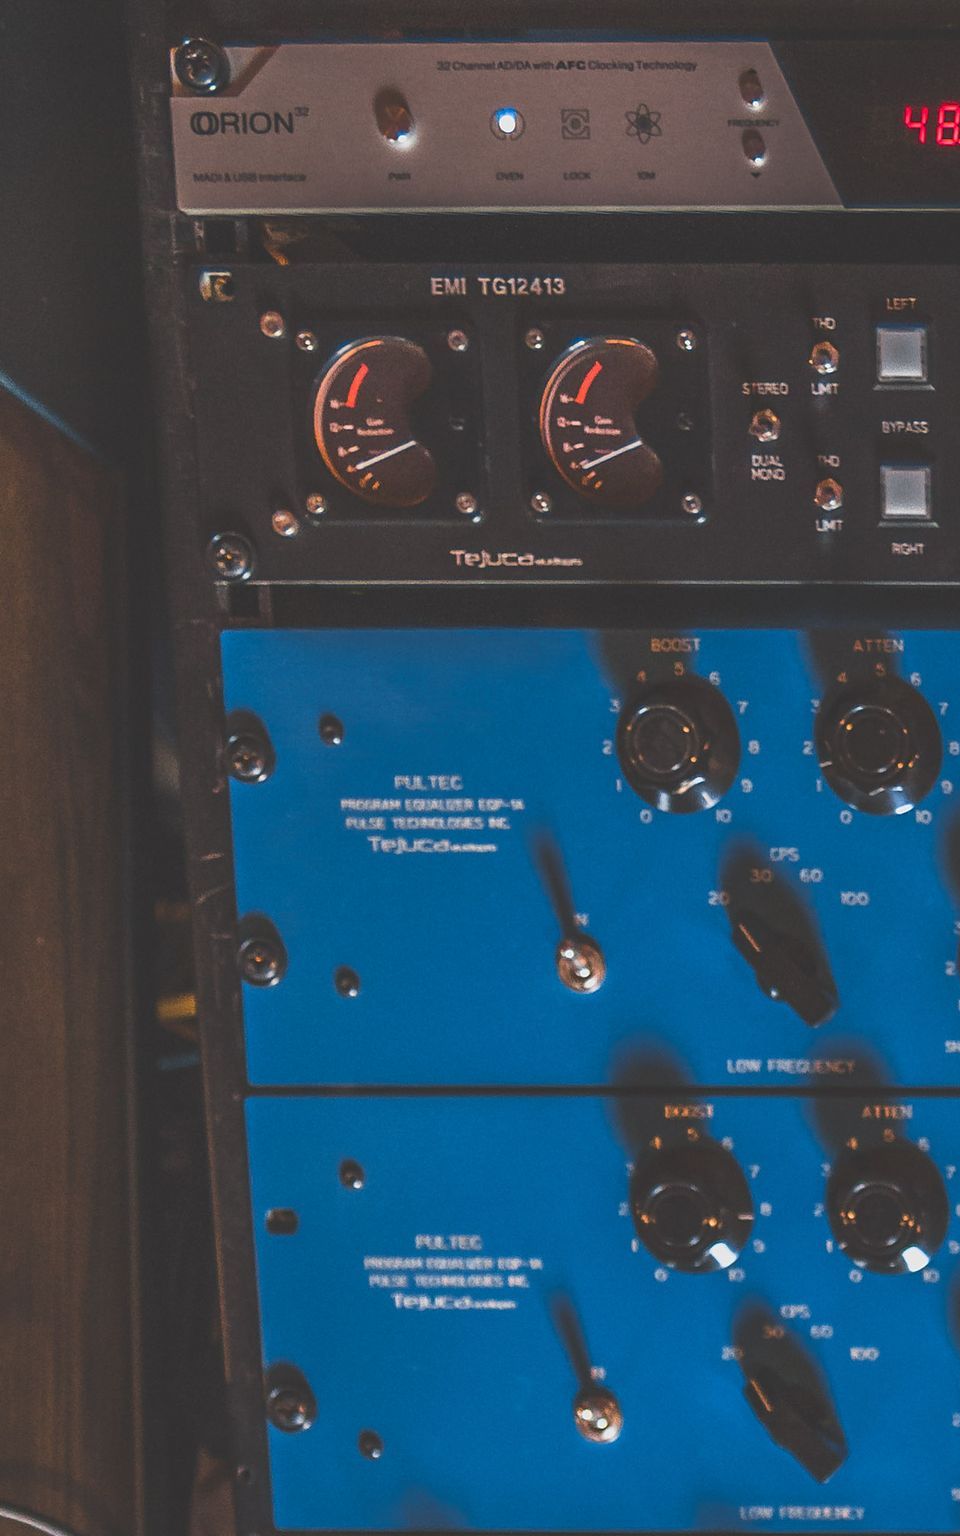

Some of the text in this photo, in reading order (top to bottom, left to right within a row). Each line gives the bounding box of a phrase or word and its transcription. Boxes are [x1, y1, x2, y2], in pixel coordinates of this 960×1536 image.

[452, 60, 496, 71] Channel
[498, 60, 530, 72] AD/DA
[532, 60, 554, 71] with
[556, 60, 586, 71] AFC
[588, 60, 634, 73] Clocking
[637, 60, 697, 73] Technology
[728, 118, 780, 128] FREQUENCY
[563, 172, 591, 181] LOCK
[430, 277, 565, 295] EMI TG12413
[886, 297, 917, 310] LEFT
[813, 317, 837, 330] THD
[742, 382, 789, 395] STEREO
[881, 421, 929, 434] BYPASS
[751, 454, 783, 467] DUAL
[751, 469, 785, 481] MONO
[450, 549, 534, 568] Tejuca
[651, 638, 701, 651] BOOST
[854, 639, 904, 651] ATTEN
[394, 775, 463, 790] PULTEC
[340, 798, 401, 811] PROGRAM
[346, 817, 386, 830] PULSE
[769, 847, 799, 862] CPS
[751, 869, 773, 883] 30
[800, 869, 824, 883] 60
[708, 890, 731, 906] 20
[840, 890, 869, 906] 100
[727, 1058, 856, 1075] LOW FREQUENCY
